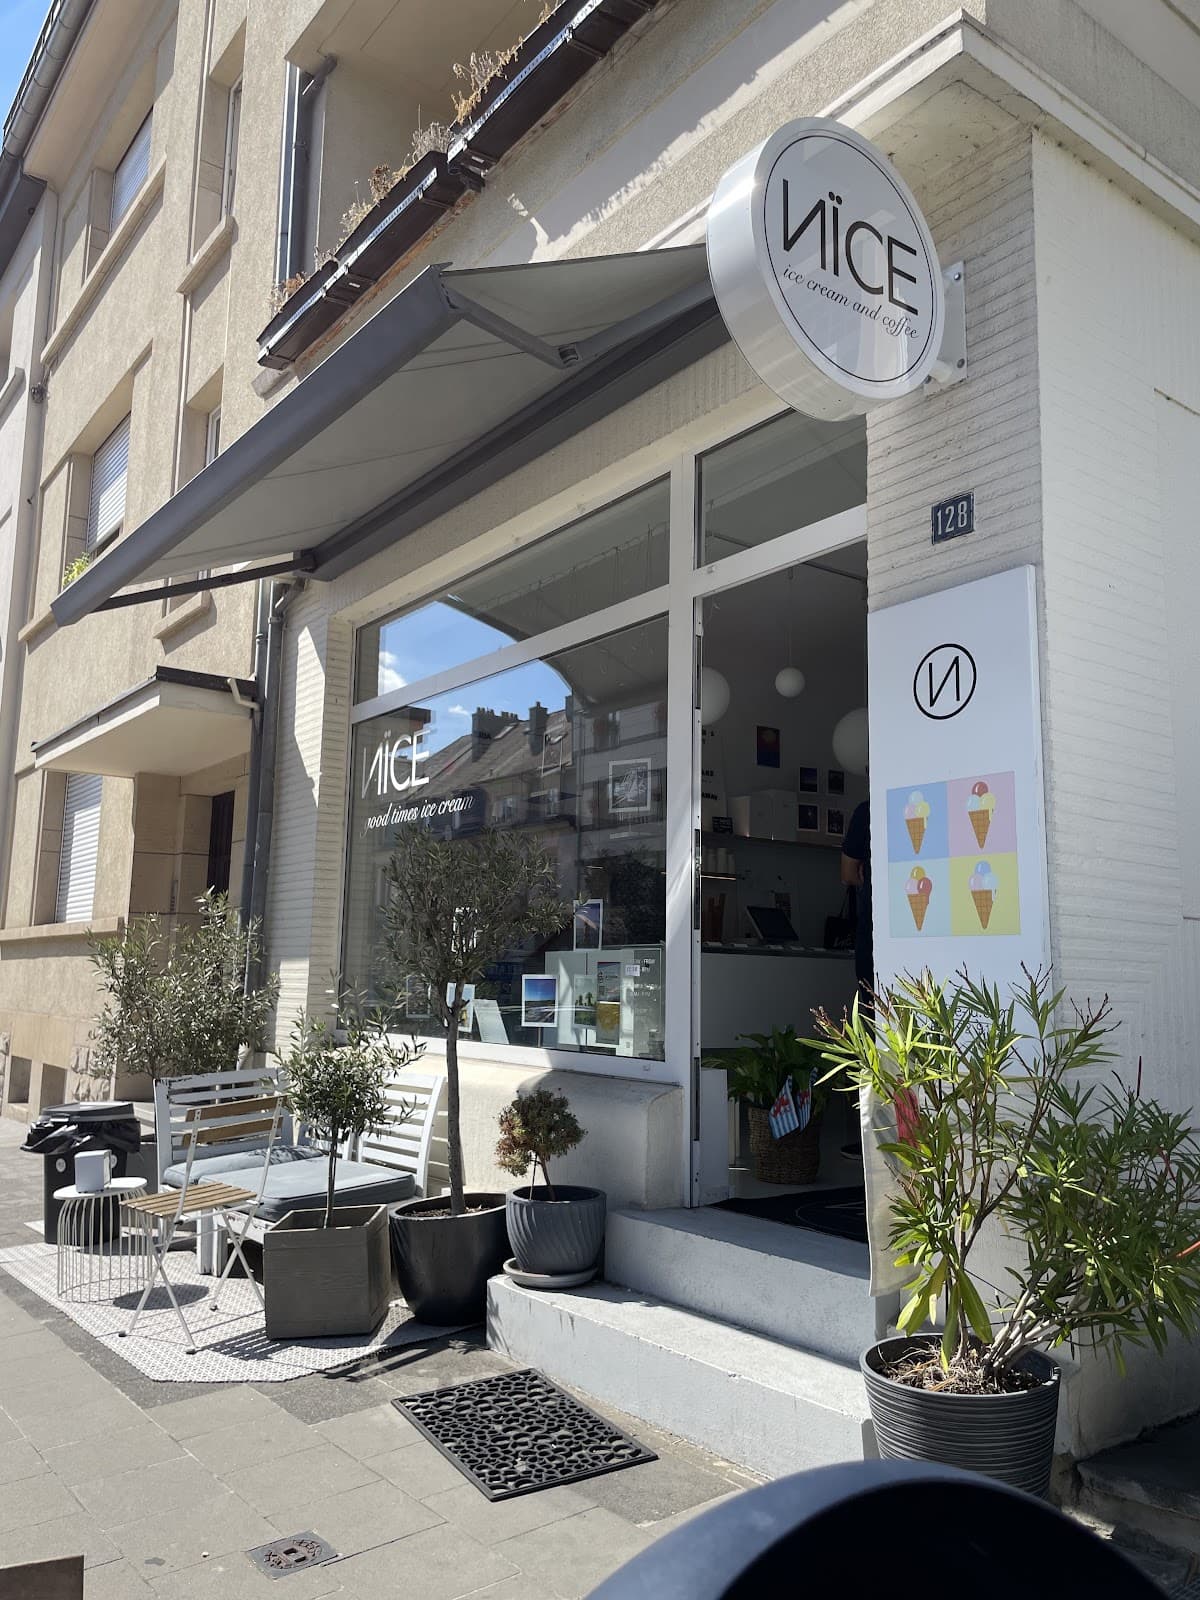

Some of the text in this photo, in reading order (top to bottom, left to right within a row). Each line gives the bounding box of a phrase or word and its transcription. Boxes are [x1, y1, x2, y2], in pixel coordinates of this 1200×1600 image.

[783, 264, 919, 339] ice cream and coffee
[937, 500, 968, 536] 128
[391, 805, 419, 825] times
[420, 799, 437, 819] ice
[438, 795, 474, 815] cream
